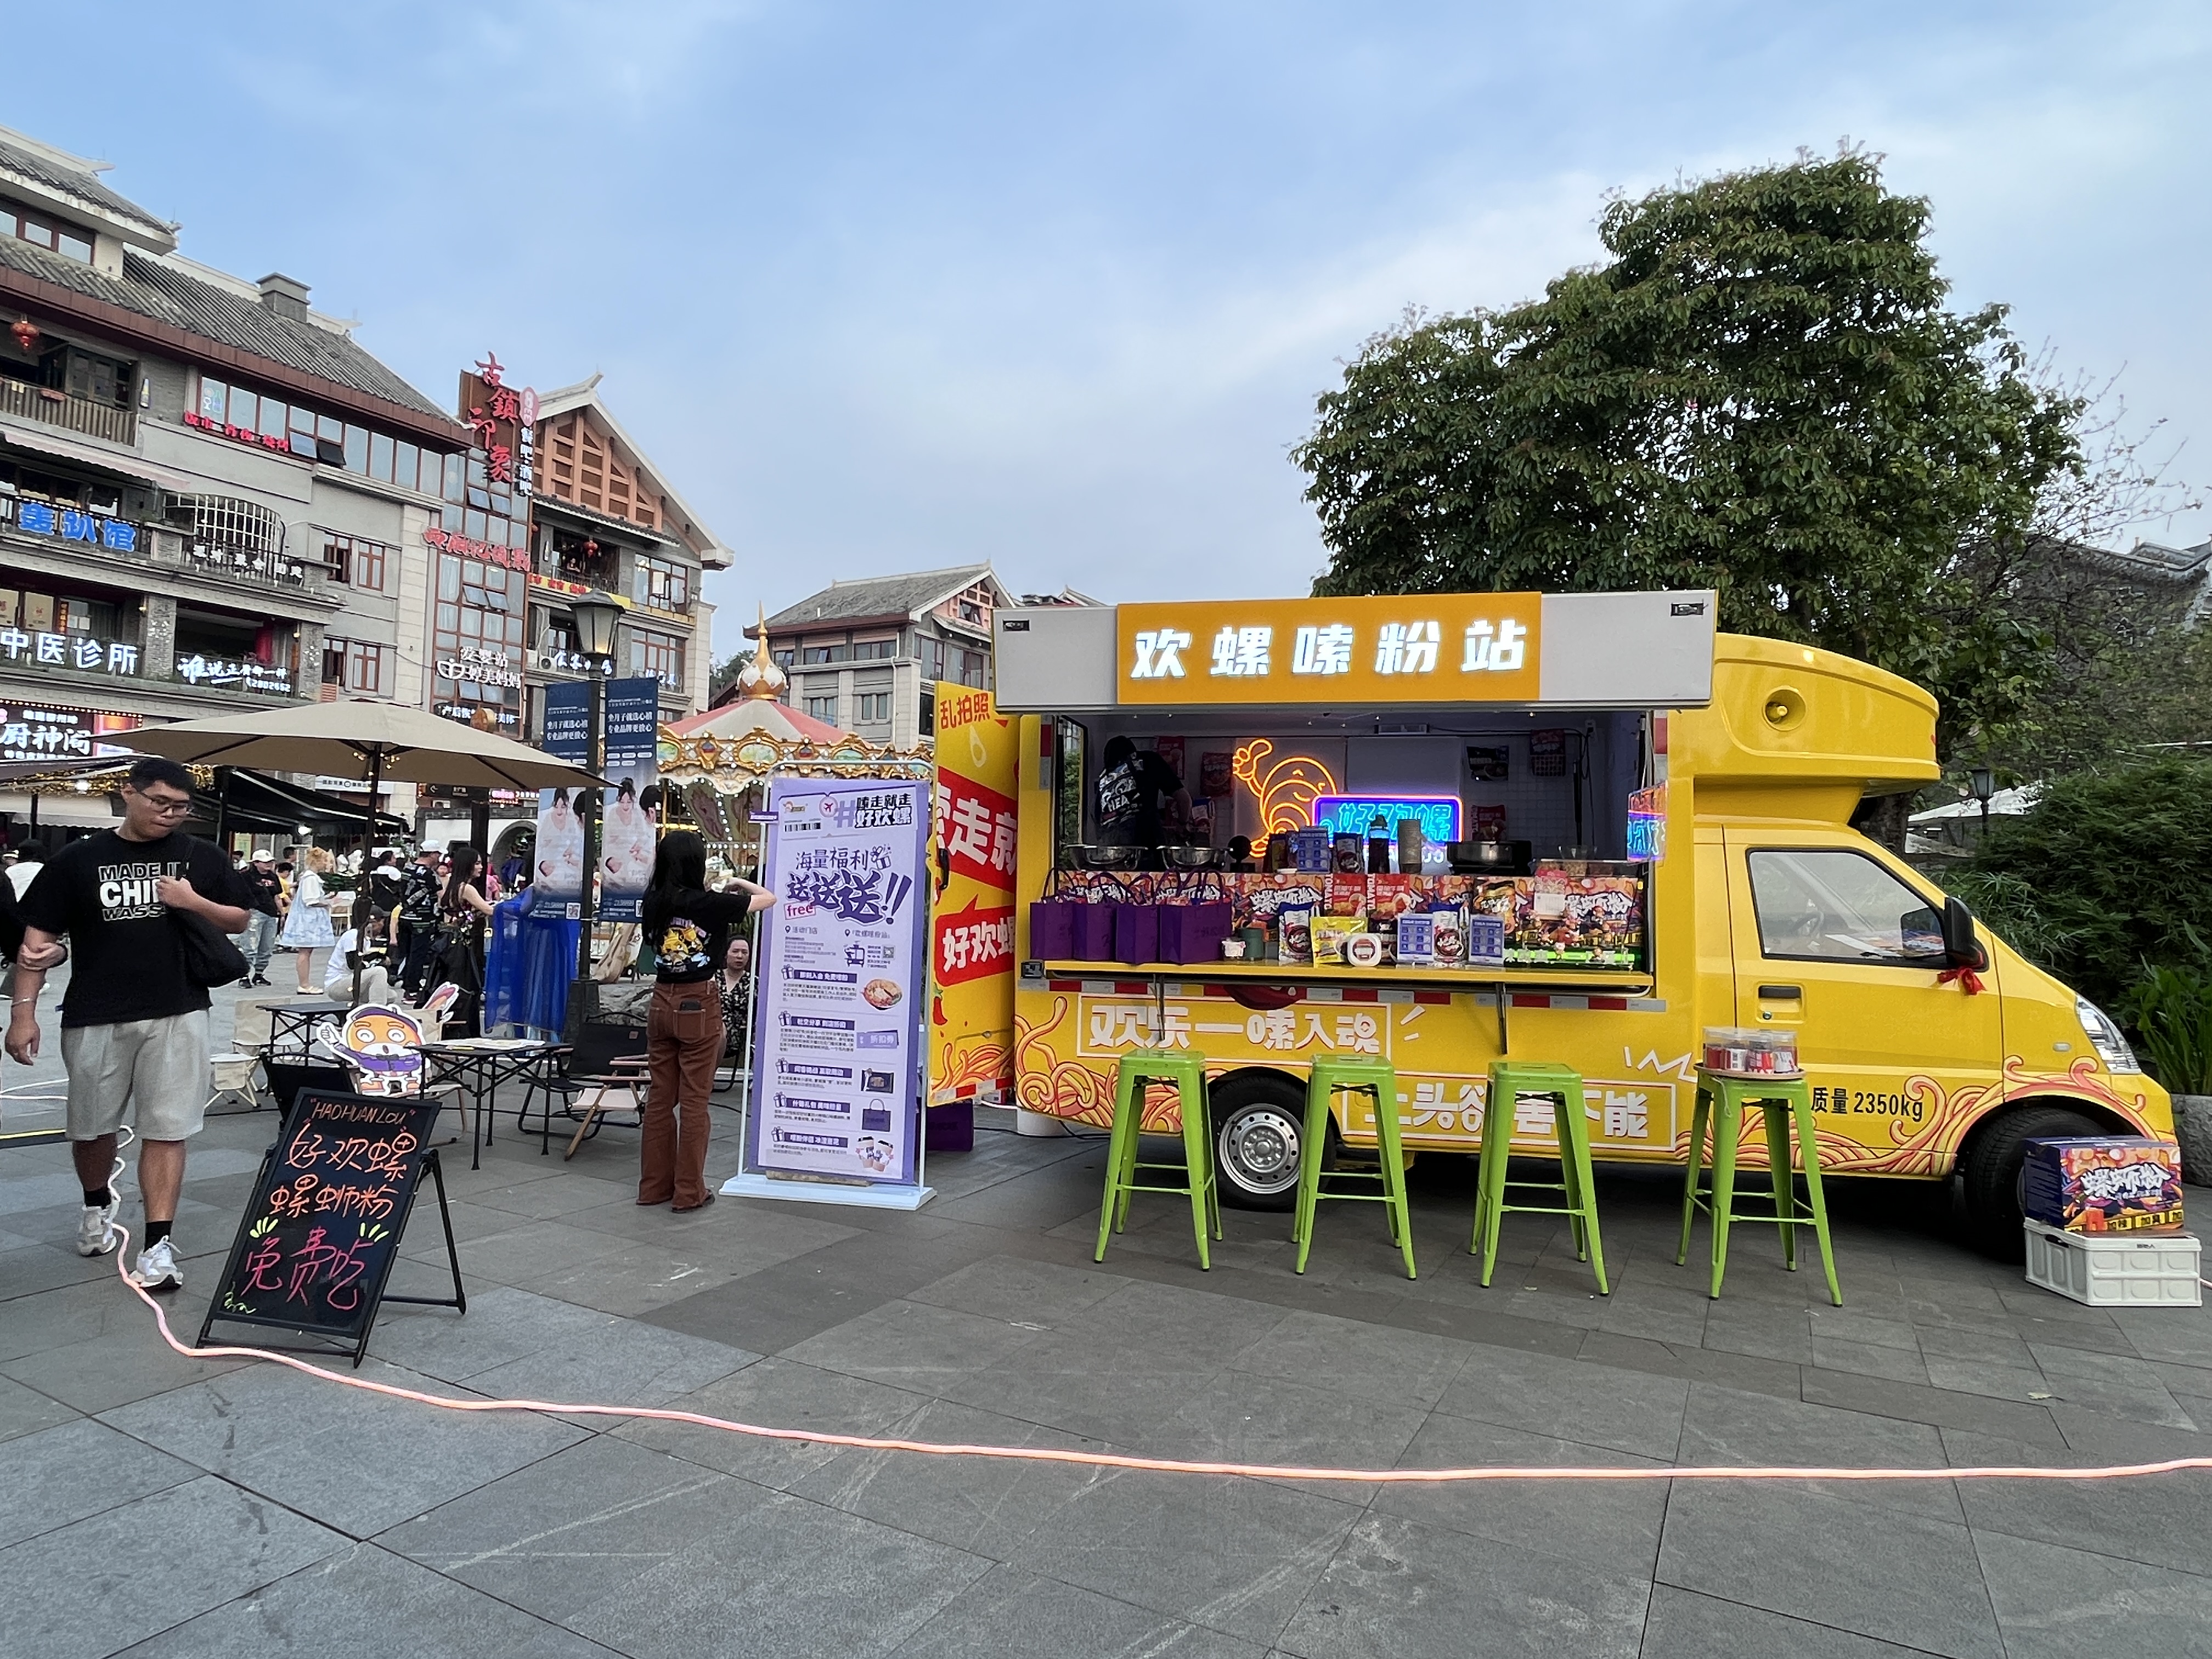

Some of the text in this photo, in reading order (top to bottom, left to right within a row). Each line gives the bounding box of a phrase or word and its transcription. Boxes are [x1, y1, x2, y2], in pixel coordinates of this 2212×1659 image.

[0, 627, 138, 675] 中医诊所
[1130, 620, 1527, 679] 欢螺嗦粉站
[940, 693, 990, 730] 乱拍照
[855, 807, 912, 827] 好欢螺
[98, 862, 161, 882] MADE
[795, 847, 868, 871] 海量福利
[786, 904, 814, 917] free
[1090, 1005, 1380, 1053] 欢乐一嗦入魂
[1811, 1087, 1923, 1122] 质量 2350kg
[285, 1122, 417, 1182] 好欢螺
[269, 1173, 399, 1220] 螺蛳粉
[240, 1226, 374, 1311] 免费吃
